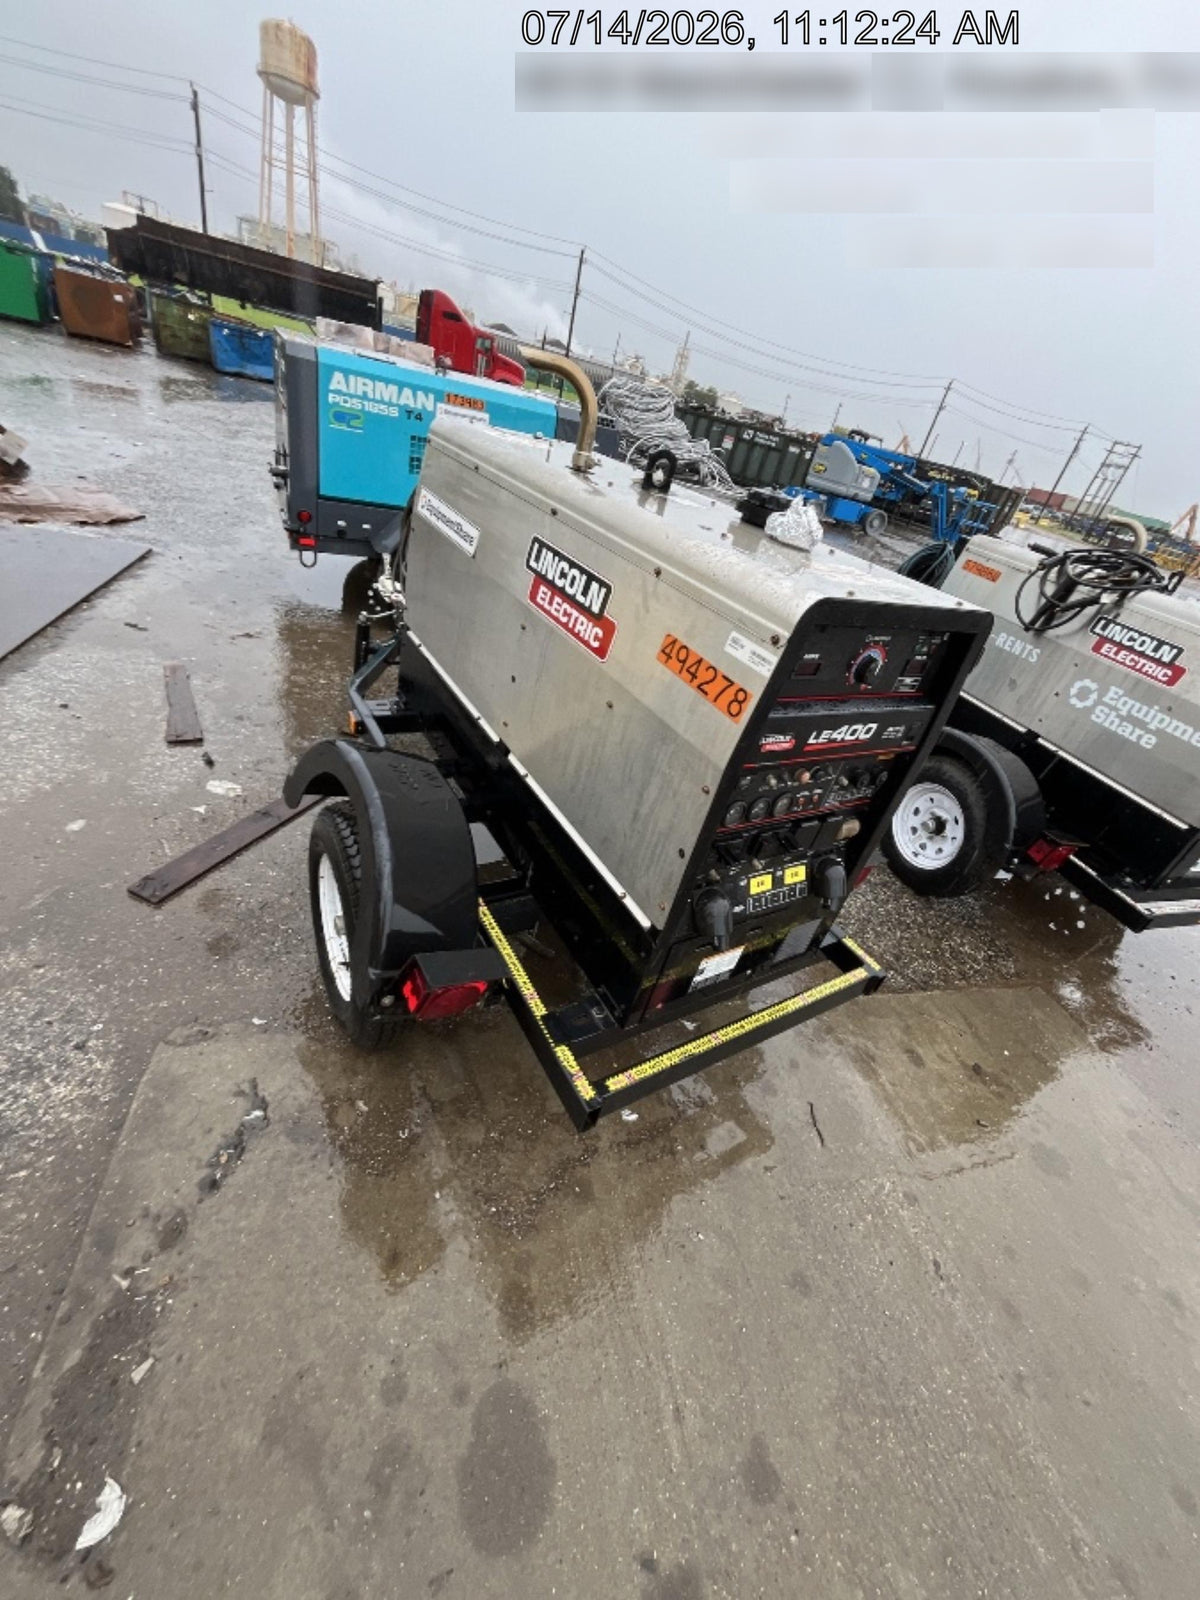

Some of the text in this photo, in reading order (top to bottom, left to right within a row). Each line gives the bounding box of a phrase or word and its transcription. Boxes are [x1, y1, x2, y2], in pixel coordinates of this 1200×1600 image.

[328, 371, 435, 412] AIRMAN
[404, 409, 424, 423] T4
[528, 541, 607, 615] LINCOLN
[536, 585, 604, 648] ELECTRIC
[1093, 618, 1178, 664] LINCOLN
[659, 636, 749, 720] 494278
[1100, 643, 1173, 682] ELECTRIC
[806, 722, 879, 745] LE400
[1091, 708, 1158, 750] Share
